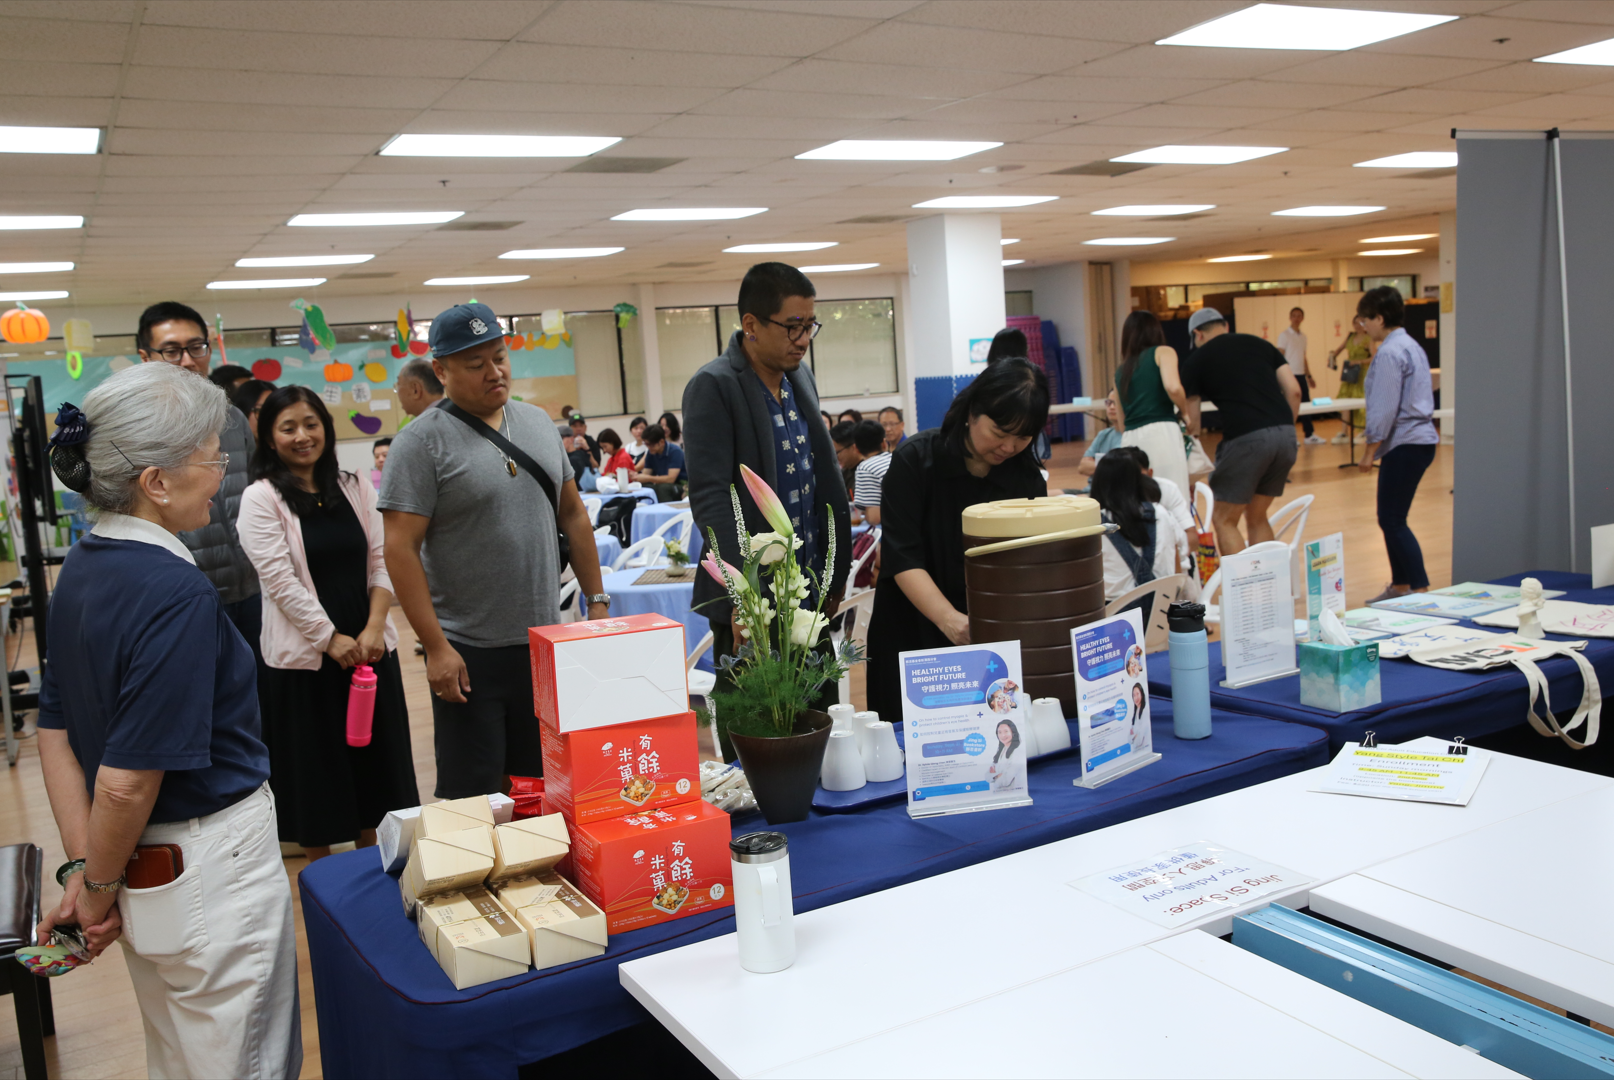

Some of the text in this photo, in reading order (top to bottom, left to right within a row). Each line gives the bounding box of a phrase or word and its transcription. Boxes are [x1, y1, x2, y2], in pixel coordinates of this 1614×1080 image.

[1100, 636, 1110, 645] EYES
[912, 667, 942, 676] HEALTHY
[912, 672, 966, 684] BRIGHT FUTURE
[638, 734, 660, 774] 有餘
[618, 747, 634, 783] 米菓
[1370, 759, 1440, 767] Enrollment
[678, 781, 687, 789] 12
[670, 840, 694, 881] 有餘
[650, 854, 667, 891] 米菓
[1174, 874, 1219, 891] Adults
[1243, 874, 1283, 886] Jing
[712, 886, 722, 894] 12
[1142, 888, 1173, 902] only
[1225, 885, 1249, 896] Si
